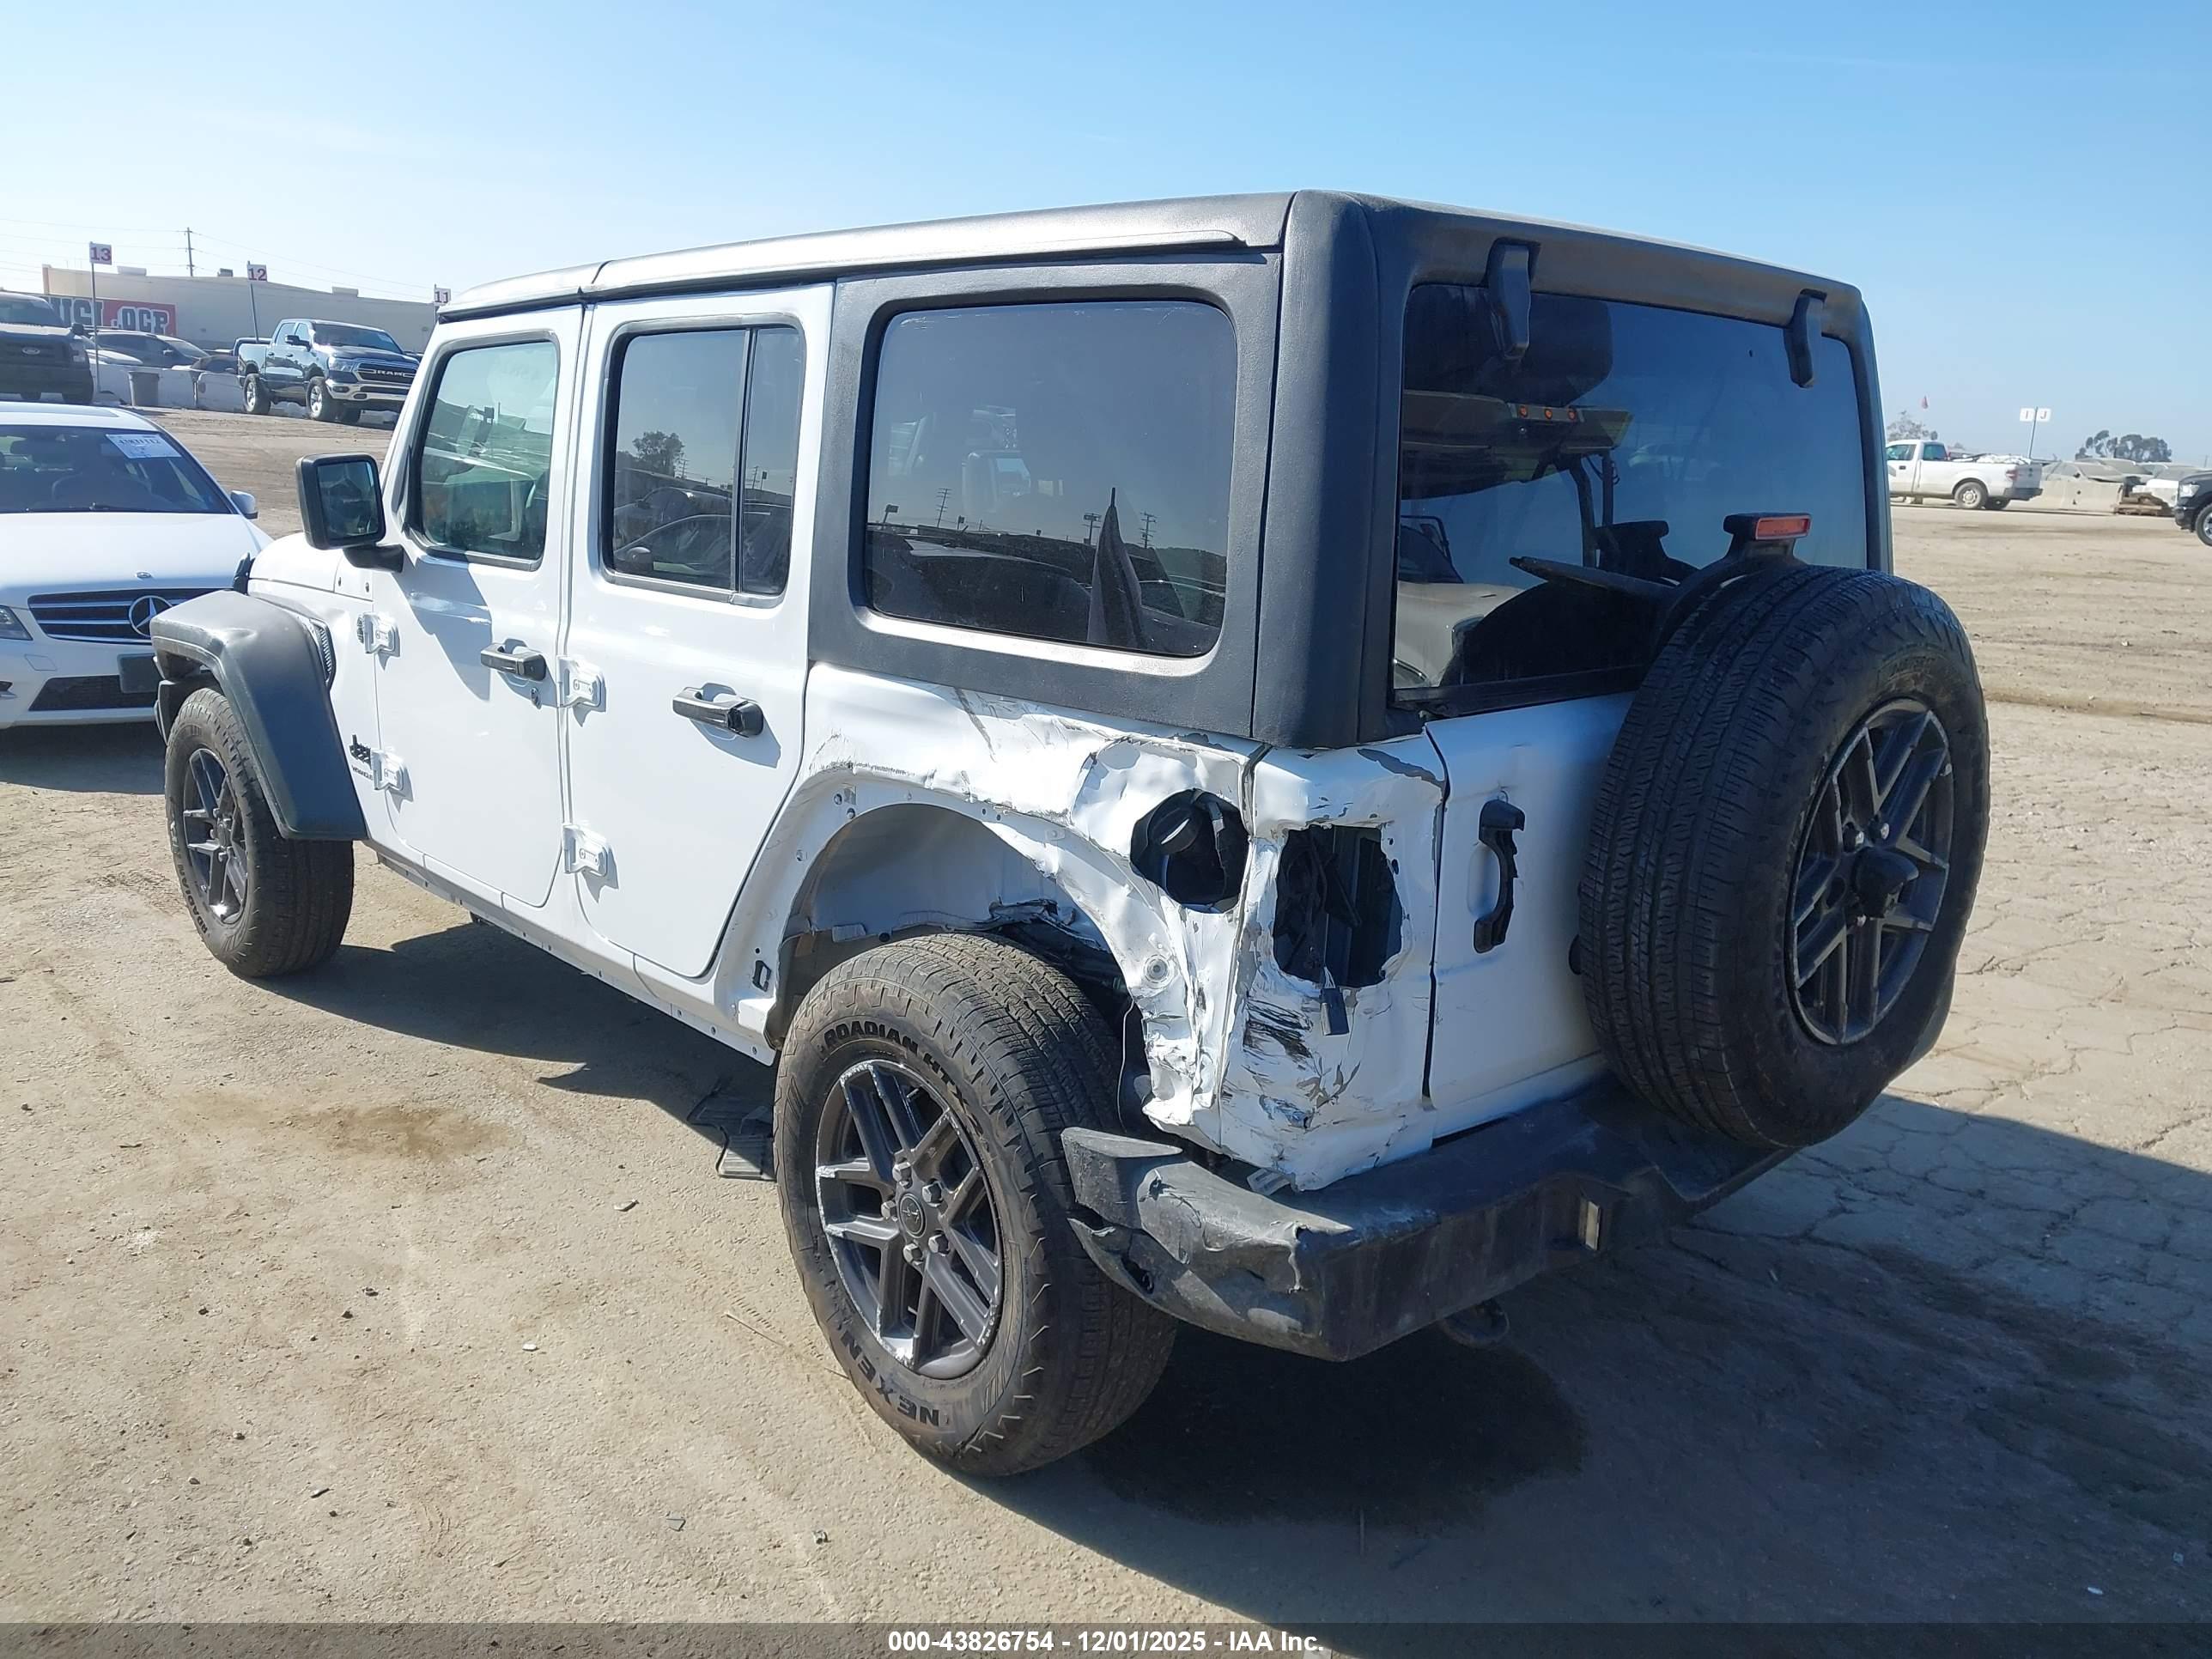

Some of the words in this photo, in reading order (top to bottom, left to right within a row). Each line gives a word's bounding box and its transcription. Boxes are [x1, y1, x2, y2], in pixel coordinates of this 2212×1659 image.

[90, 246, 112, 262] 13
[248, 268, 267, 281] 12
[434, 291, 448, 303] 11
[823, 1020, 919, 1057] ROADIAN
[840, 1330, 939, 1427] NEXEN
